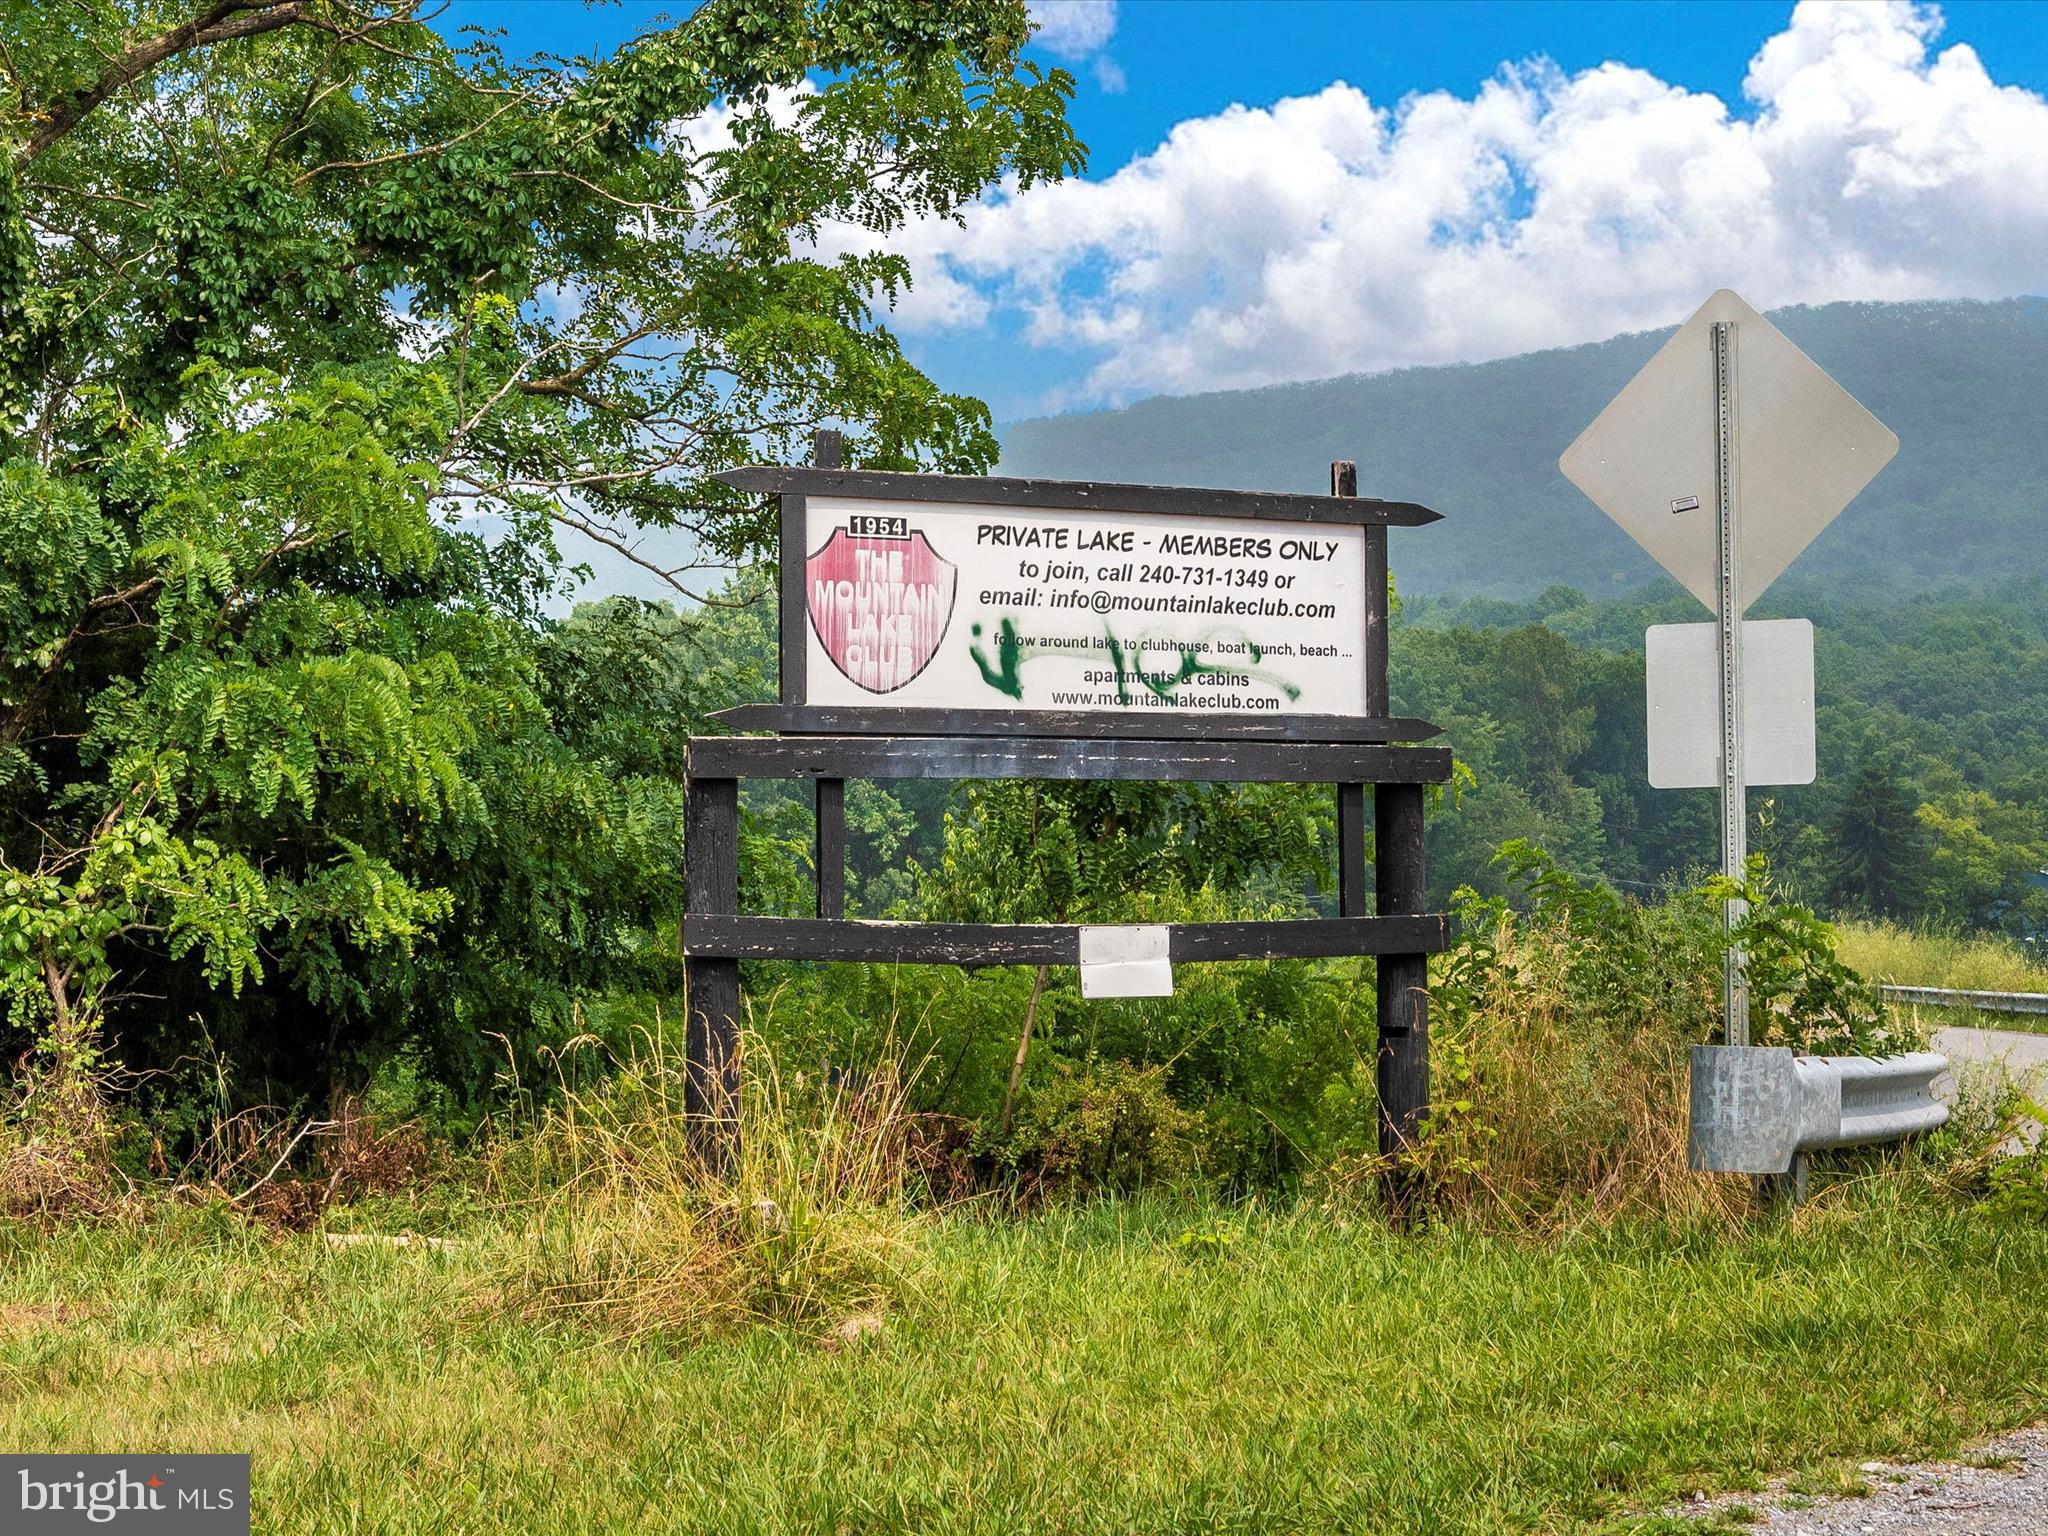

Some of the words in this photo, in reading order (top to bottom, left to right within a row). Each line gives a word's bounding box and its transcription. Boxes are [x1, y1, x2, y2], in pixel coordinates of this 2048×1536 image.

[853, 517, 904, 535] 1954
[977, 525, 1069, 550] PRIVATE
[1077, 529, 1135, 553] LAKE
[1159, 534, 1272, 559] MEMBERS
[1279, 540, 1339, 562] ONLY
[855, 549, 904, 582] THE
[1019, 560, 1040, 578] to
[1042, 560, 1090, 584] join,
[1097, 564, 1134, 582] call
[1139, 565, 1268, 589] 240-731-1349
[1274, 574, 1296, 589] or
[815, 579, 946, 615] MOUNTAIN
[979, 588, 1043, 607] email:
[1050, 589, 1336, 619] info@mountainlakeclub.com
[847, 612, 913, 645] LAKE
[846, 643, 913, 673] CLUB
[1039, 635, 1089, 649] around
[1092, 636, 1121, 651] lake
[1124, 639, 1138, 650] to
[1141, 638, 1214, 655] clubhouse,
[1217, 641, 1247, 655] boat
[1249, 643, 1297, 659] launch,
[1299, 643, 1338, 657] beach
[1083, 669, 1176, 686] apartments
[1180, 673, 1193, 686] &
[1197, 672, 1250, 687] cabins
[1052, 691, 1280, 711] www.mountainlakeclub.com
